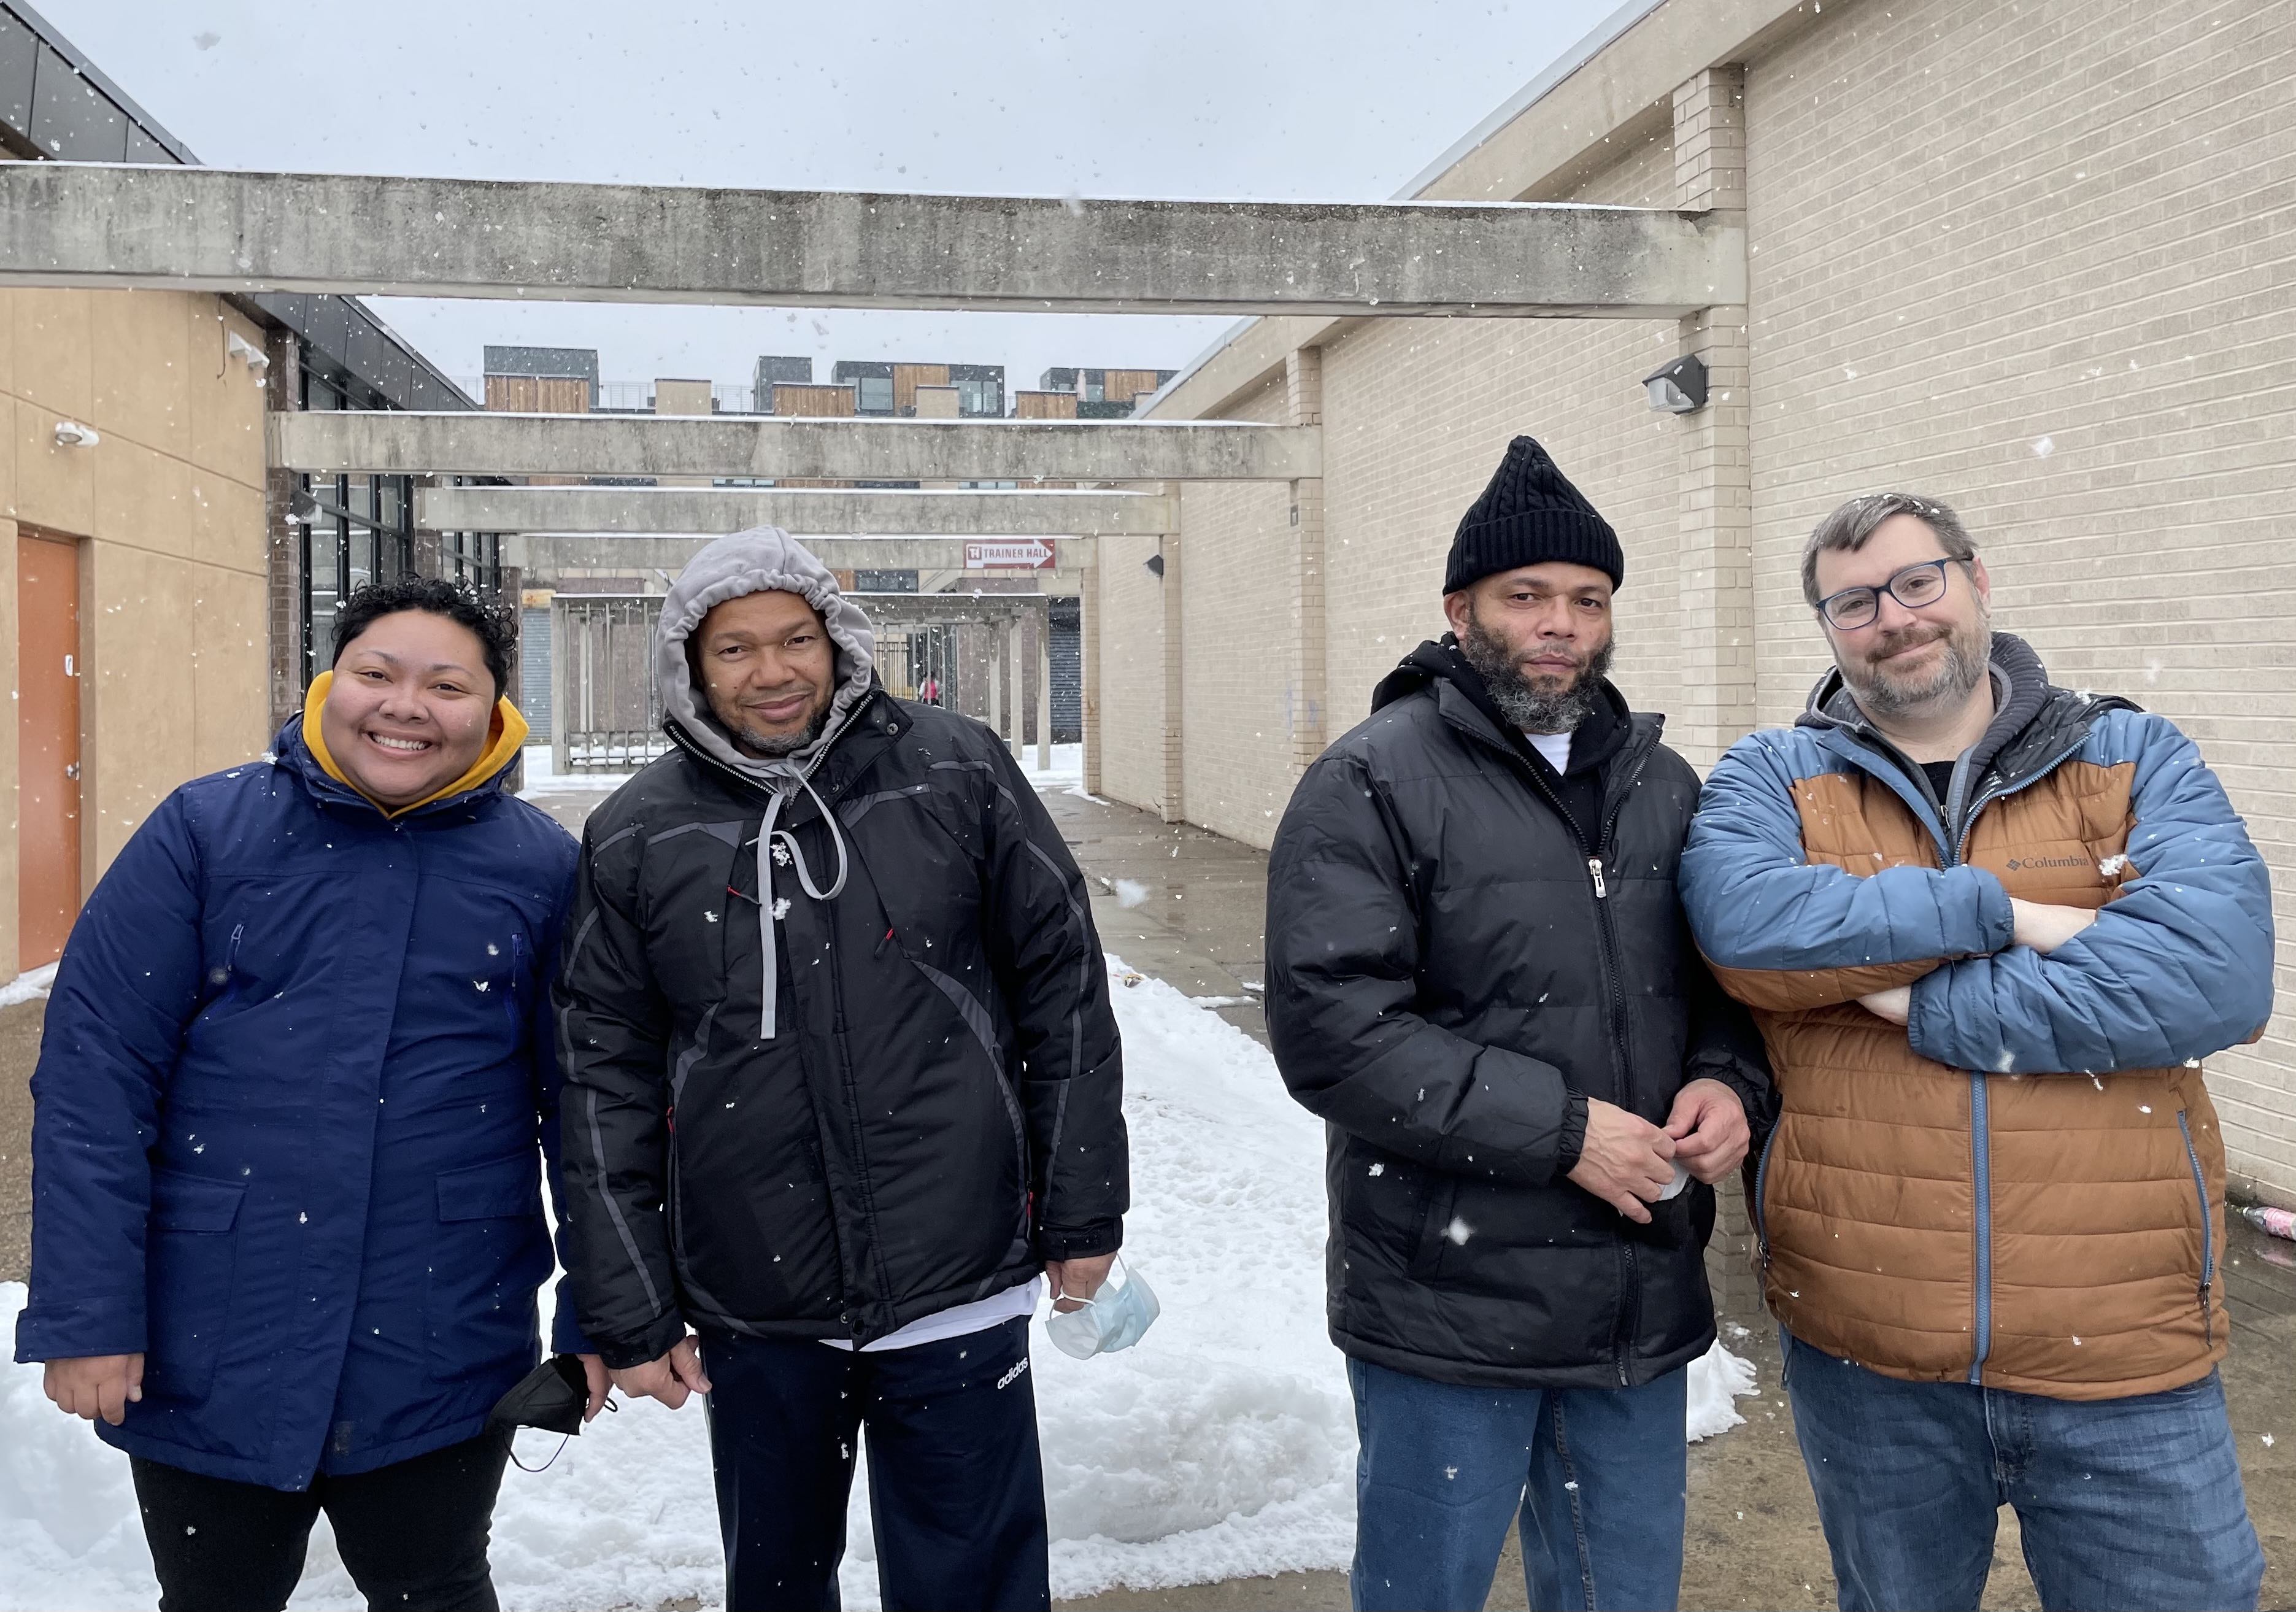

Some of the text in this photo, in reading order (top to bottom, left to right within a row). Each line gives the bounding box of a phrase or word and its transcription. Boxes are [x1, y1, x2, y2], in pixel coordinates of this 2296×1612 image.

[984, 549, 1023, 558] TRAINER
[1027, 549, 1049, 558] HALL
[2022, 855, 2089, 869] Columbia
[997, 1357, 1028, 1390] adidas
